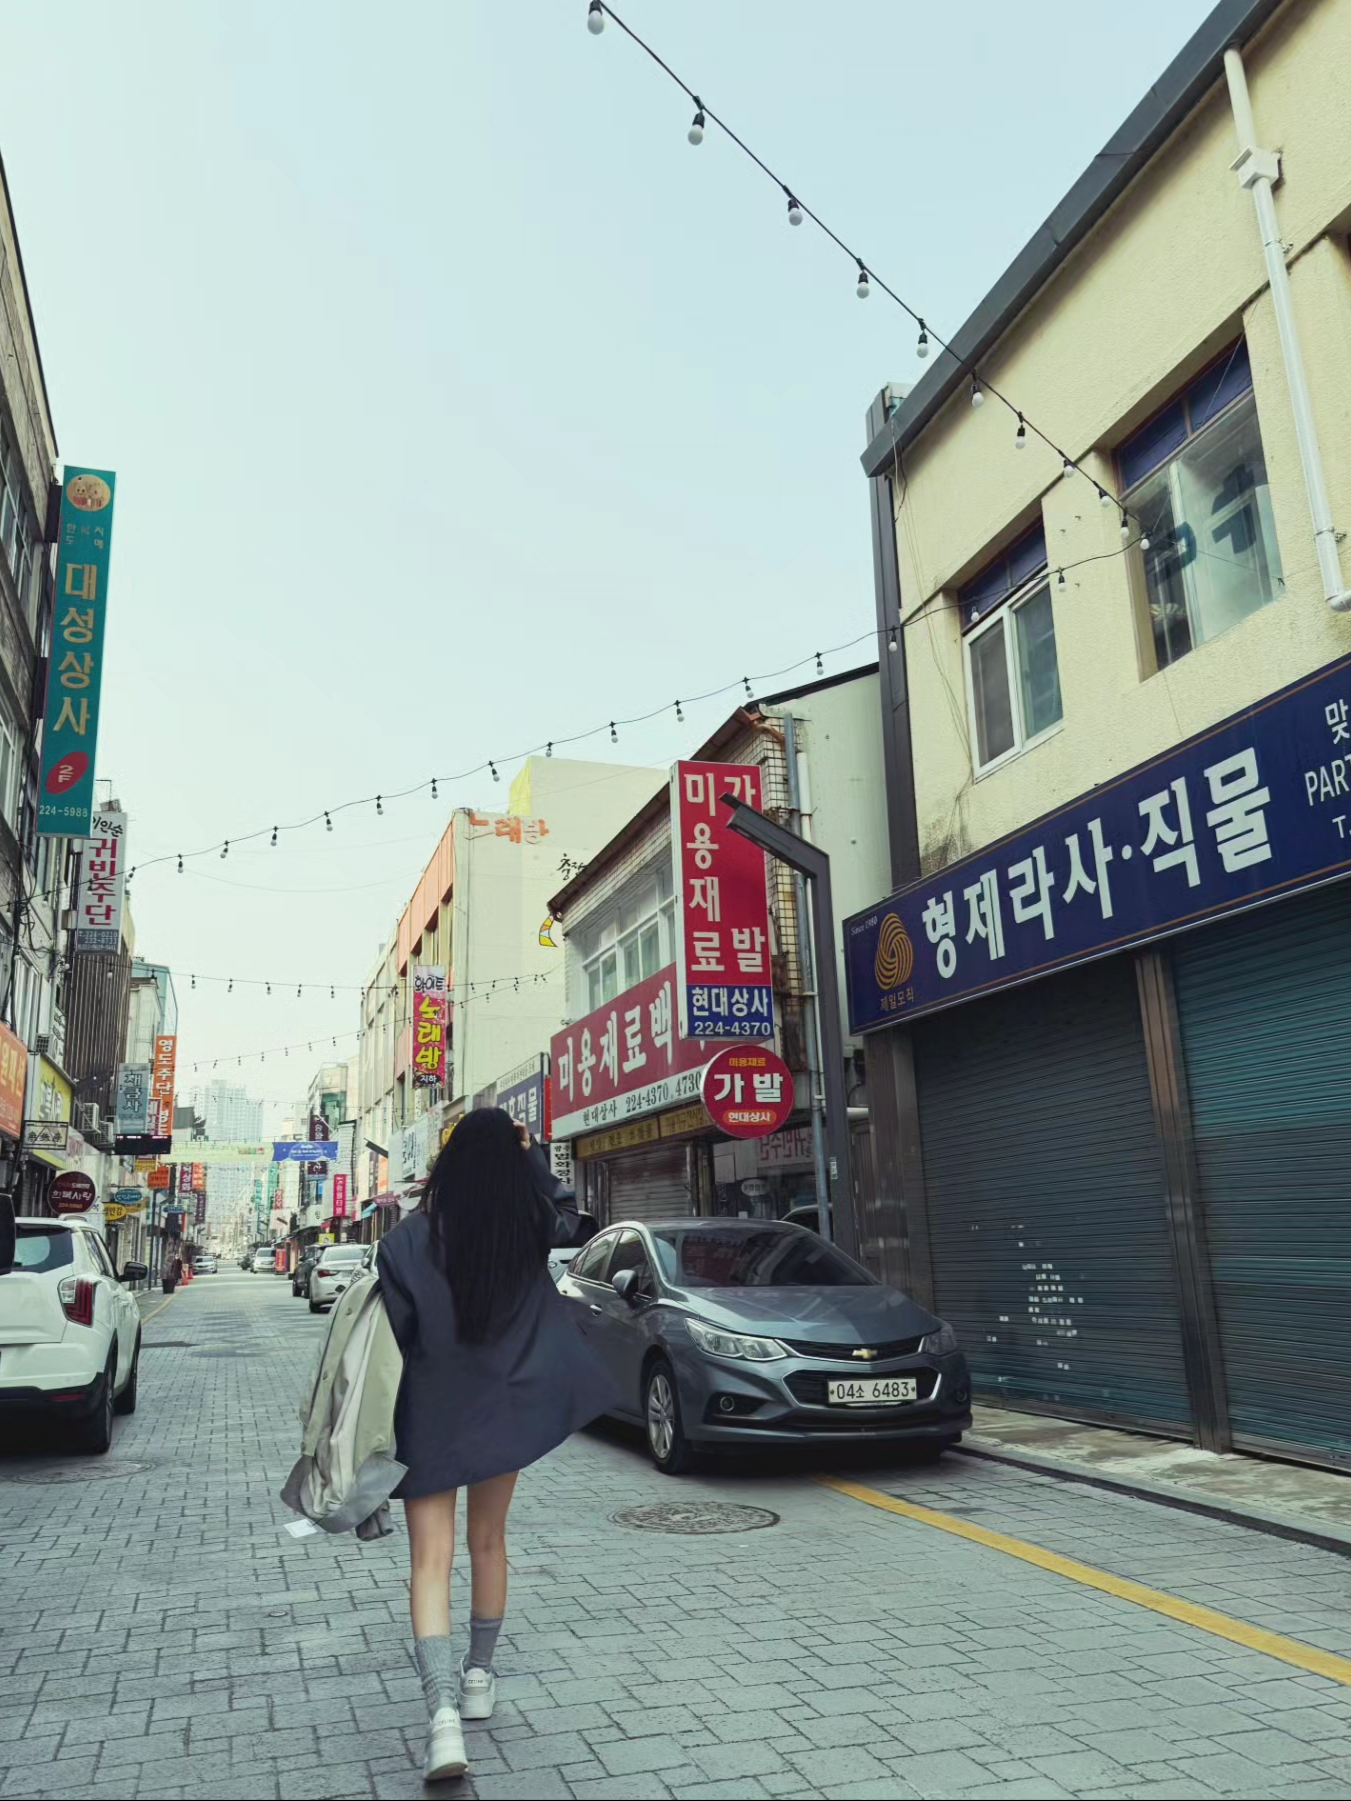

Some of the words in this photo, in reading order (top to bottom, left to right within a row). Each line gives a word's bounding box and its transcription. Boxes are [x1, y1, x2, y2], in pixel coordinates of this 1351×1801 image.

[53, 562, 98, 736] 대성상사
[58, 765, 73, 784] 2F
[39, 805, 88, 818] 224-5988
[683, 772, 725, 972] 미용재료
[414, 975, 444, 993] 화이트
[691, 988, 769, 1017] 현대상사
[881, 986, 914, 1011] 제일모직
[416, 995, 442, 1070] 노래방
[694, 1021, 771, 1036] 224-4370
[156, 1039, 173, 1096] 영도주단
[729, 1057, 766, 1067] 미용재료
[420, 1074, 438, 1083] 지하
[712, 1073, 784, 1103] 가발
[582, 1099, 617, 1127] 현대상사
[728, 1111, 770, 1122] 현대상사
[837, 1383, 864, 1399] 04소
[872, 1381, 909, 1398] 6483
